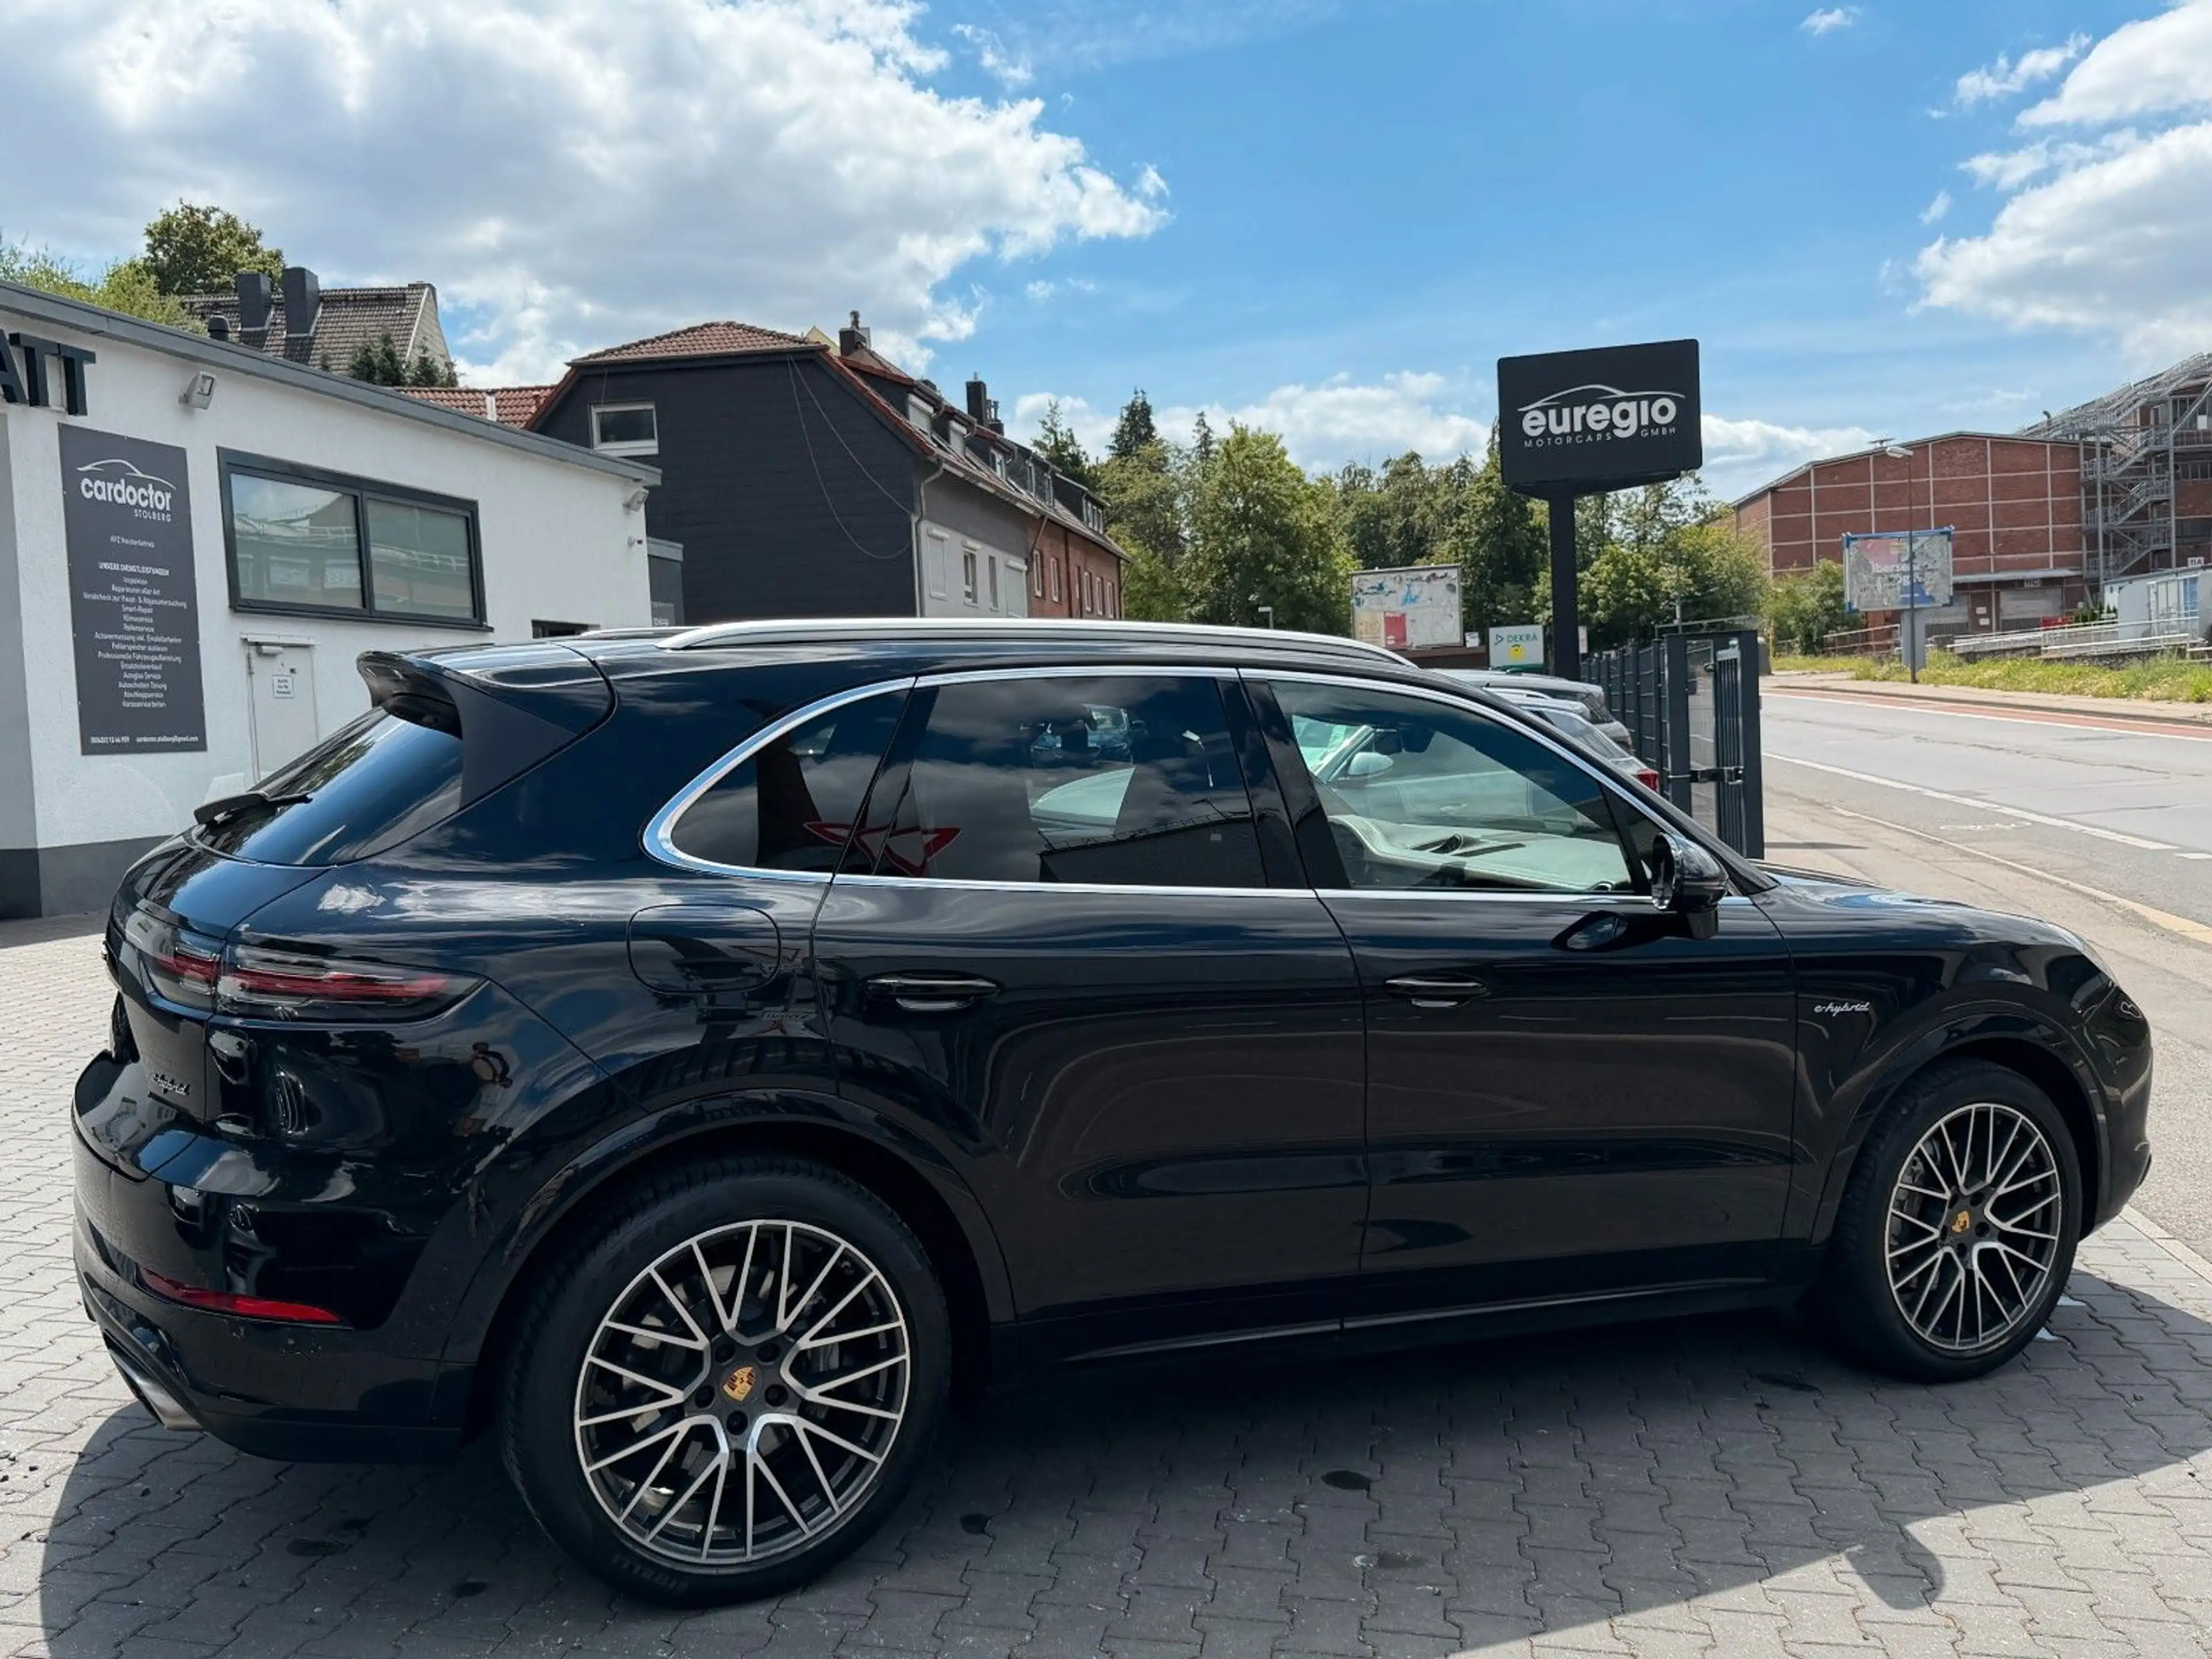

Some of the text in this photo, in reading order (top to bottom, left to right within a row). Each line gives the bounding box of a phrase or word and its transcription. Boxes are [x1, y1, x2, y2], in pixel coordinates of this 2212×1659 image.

[1522, 397, 1677, 438] euregio
[1524, 433, 1612, 448] MOTORCARS
[80, 478, 172, 511] cardoctor
[134, 509, 172, 522] STOLBERG
[1507, 632, 1537, 643] DEKRA
